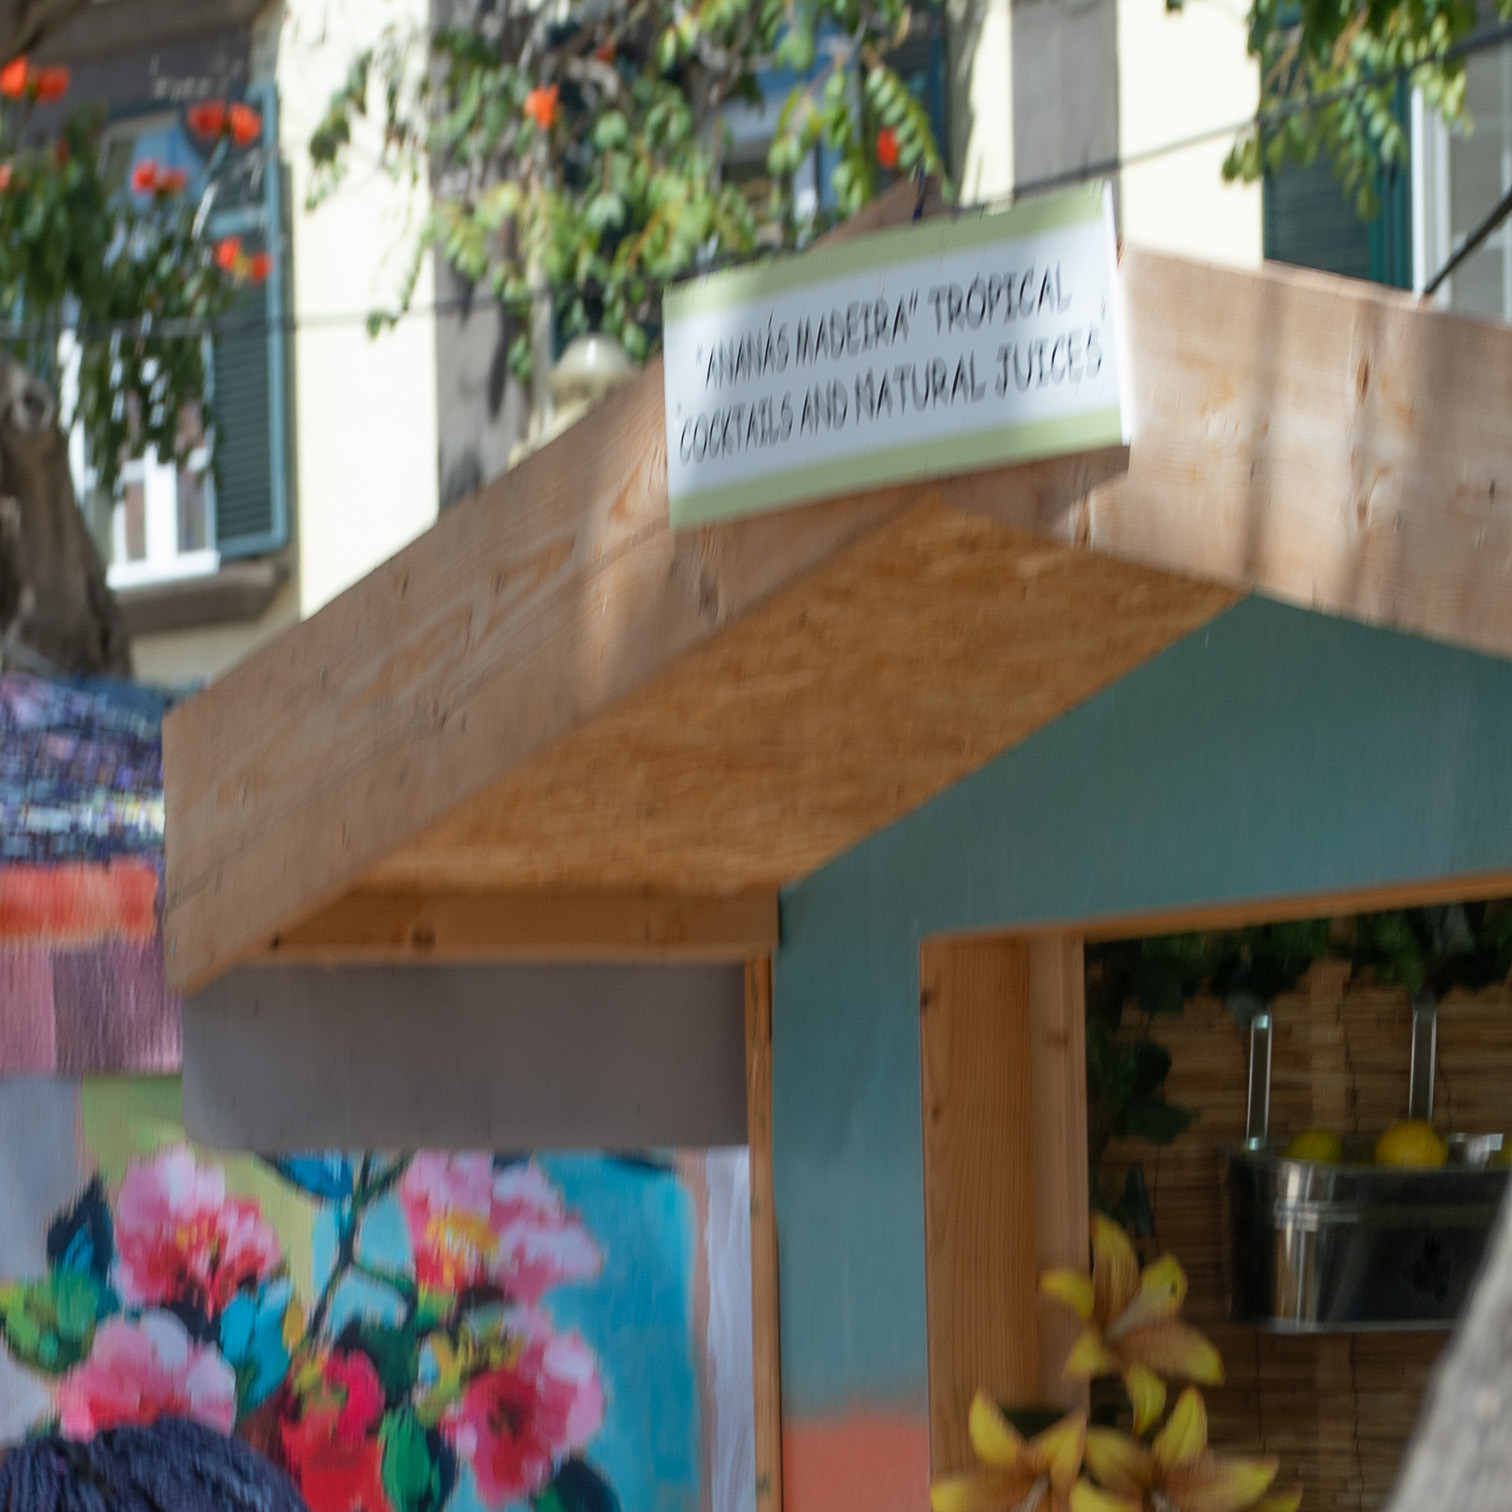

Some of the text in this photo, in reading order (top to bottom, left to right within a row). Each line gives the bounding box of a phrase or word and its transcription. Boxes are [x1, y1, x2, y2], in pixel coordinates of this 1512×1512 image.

[928, 261, 1072, 336] TROPICAL
[679, 327, 1102, 464] COCKTAILS AND NATURAL JUICES
